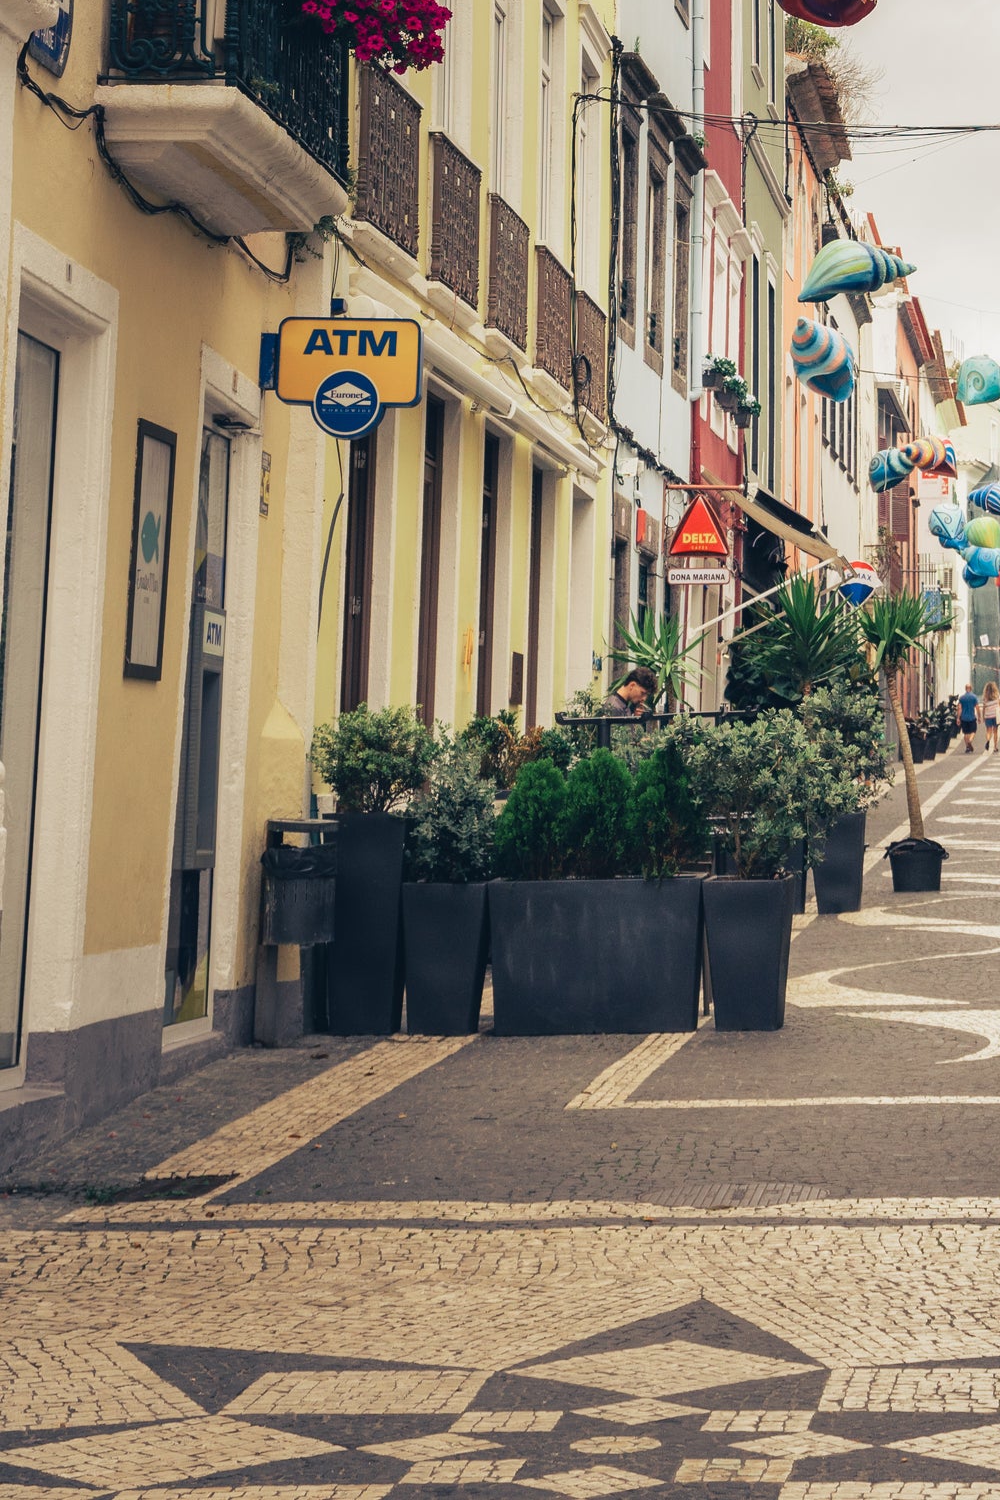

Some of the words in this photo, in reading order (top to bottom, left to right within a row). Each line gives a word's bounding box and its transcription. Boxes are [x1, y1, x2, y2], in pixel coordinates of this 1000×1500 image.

[303, 329, 398, 357] ATM
[330, 390, 364, 399] Euronet
[682, 533, 718, 544] DELTA
[670, 573, 691, 581] DONA
[692, 573, 726, 581] MARIANA
[206, 621, 222, 647] ATM
